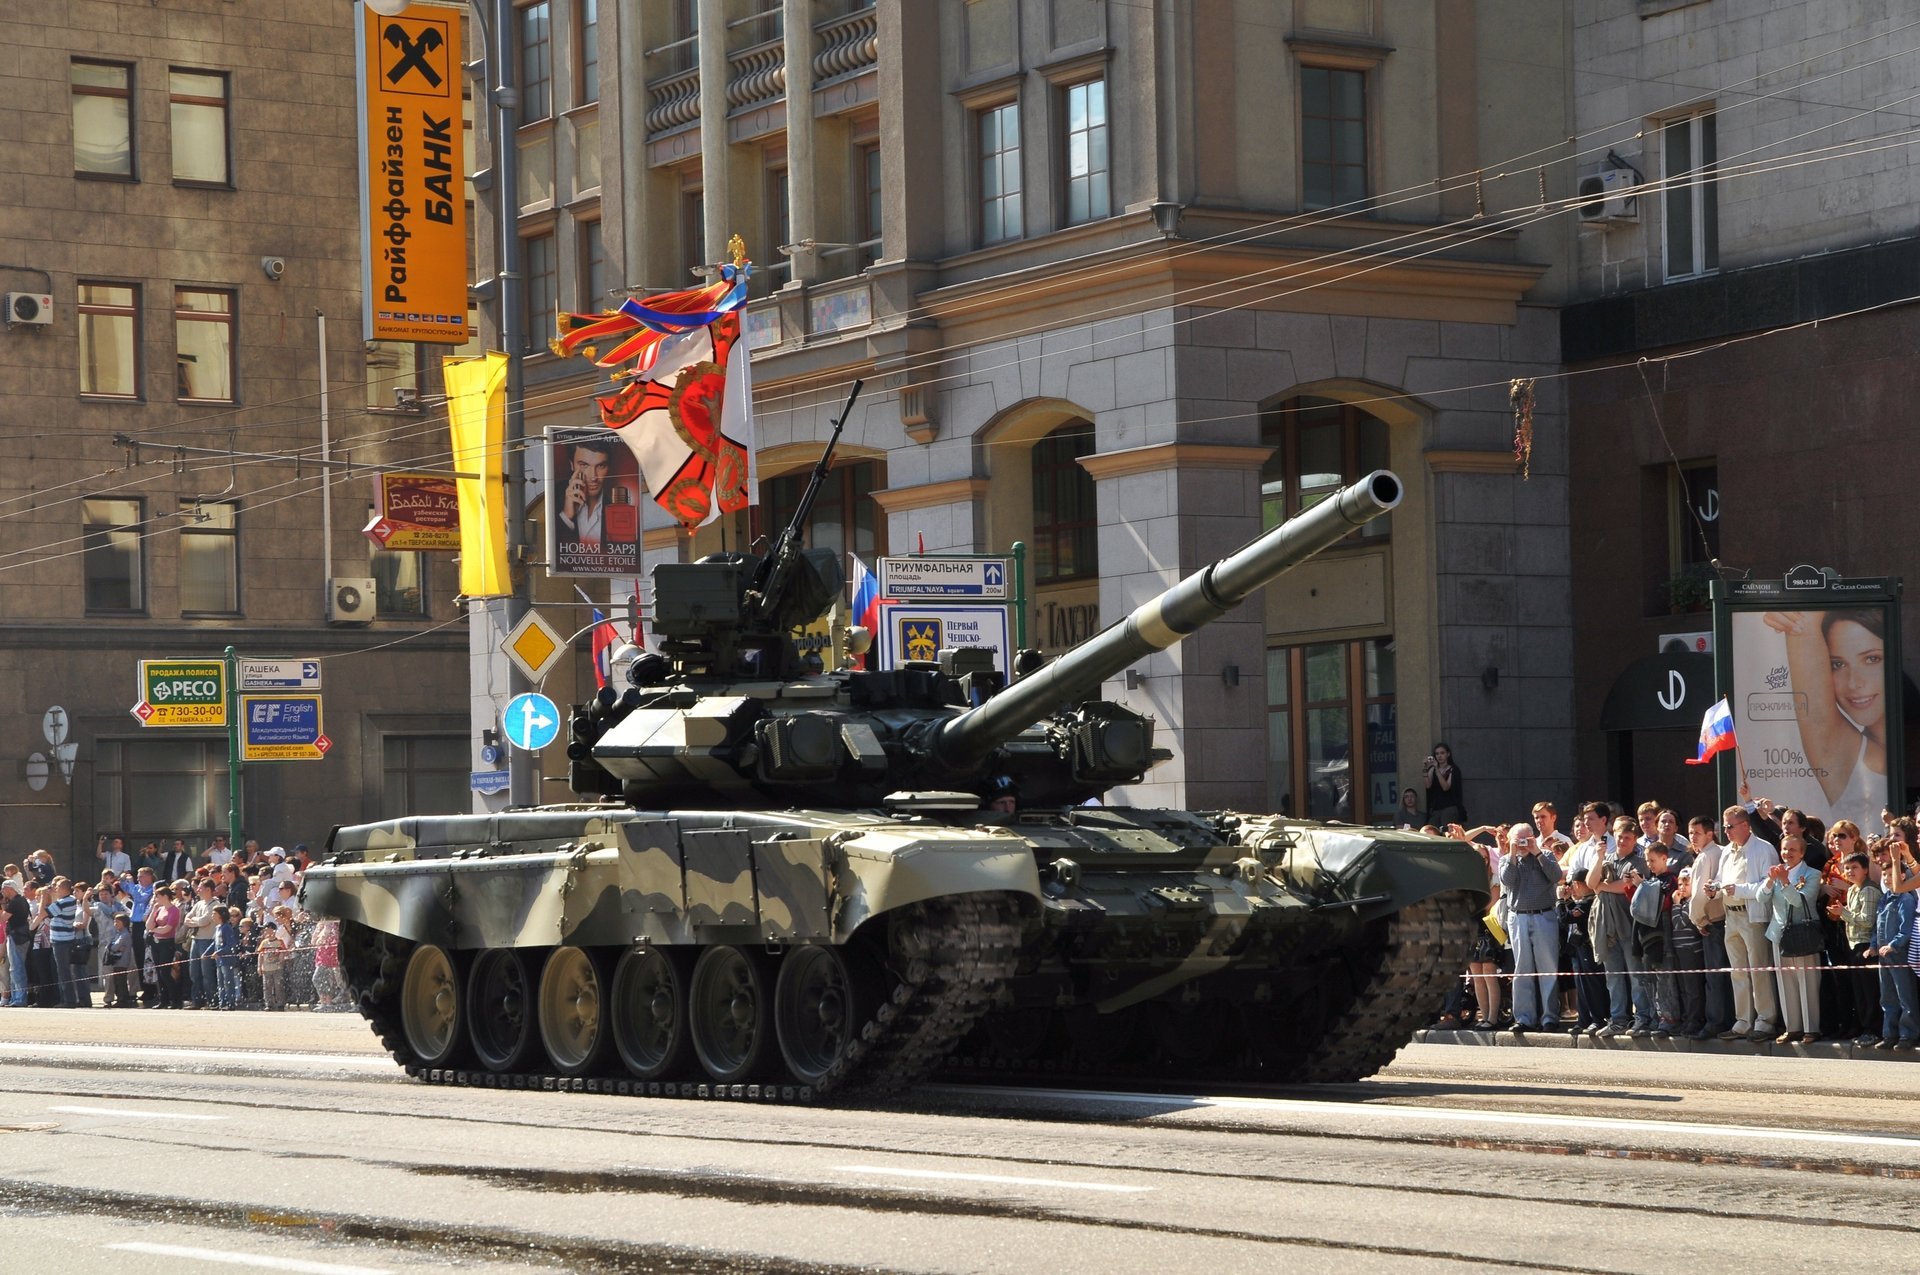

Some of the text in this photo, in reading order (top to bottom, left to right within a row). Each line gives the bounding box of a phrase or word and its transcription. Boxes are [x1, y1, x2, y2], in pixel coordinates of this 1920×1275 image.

[422, 110, 454, 226] БАНК
[382, 106, 411, 303] Райффайзен
[411, 328, 459, 336] КРУГЛОСУТОЧНО
[389, 492, 432, 510] Бабай
[559, 542, 636, 555] НОВАЯ ЗАРЯ
[559, 555, 636, 566] NOUVELLE ETOILE
[888, 563, 974, 574] ТРИУМФАЛЬНАЯ
[889, 573, 922, 581] площадь
[150, 669, 185, 677] ПРОДАЖА
[244, 665, 280, 673] ГАШЕКА
[1770, 665, 1788, 676] Lady
[1764, 671, 1789, 684] Speed
[172, 681, 217, 697] РЕСО
[1768, 680, 1787, 691] Stick
[169, 706, 223, 716] 730-30-00
[252, 703, 281, 723] EF
[284, 703, 313, 714] English
[282, 714, 301, 723] First
[486, 749, 491, 760] 5
[1763, 748, 1804, 765] 100%
[1744, 767, 1829, 781] уверенность
